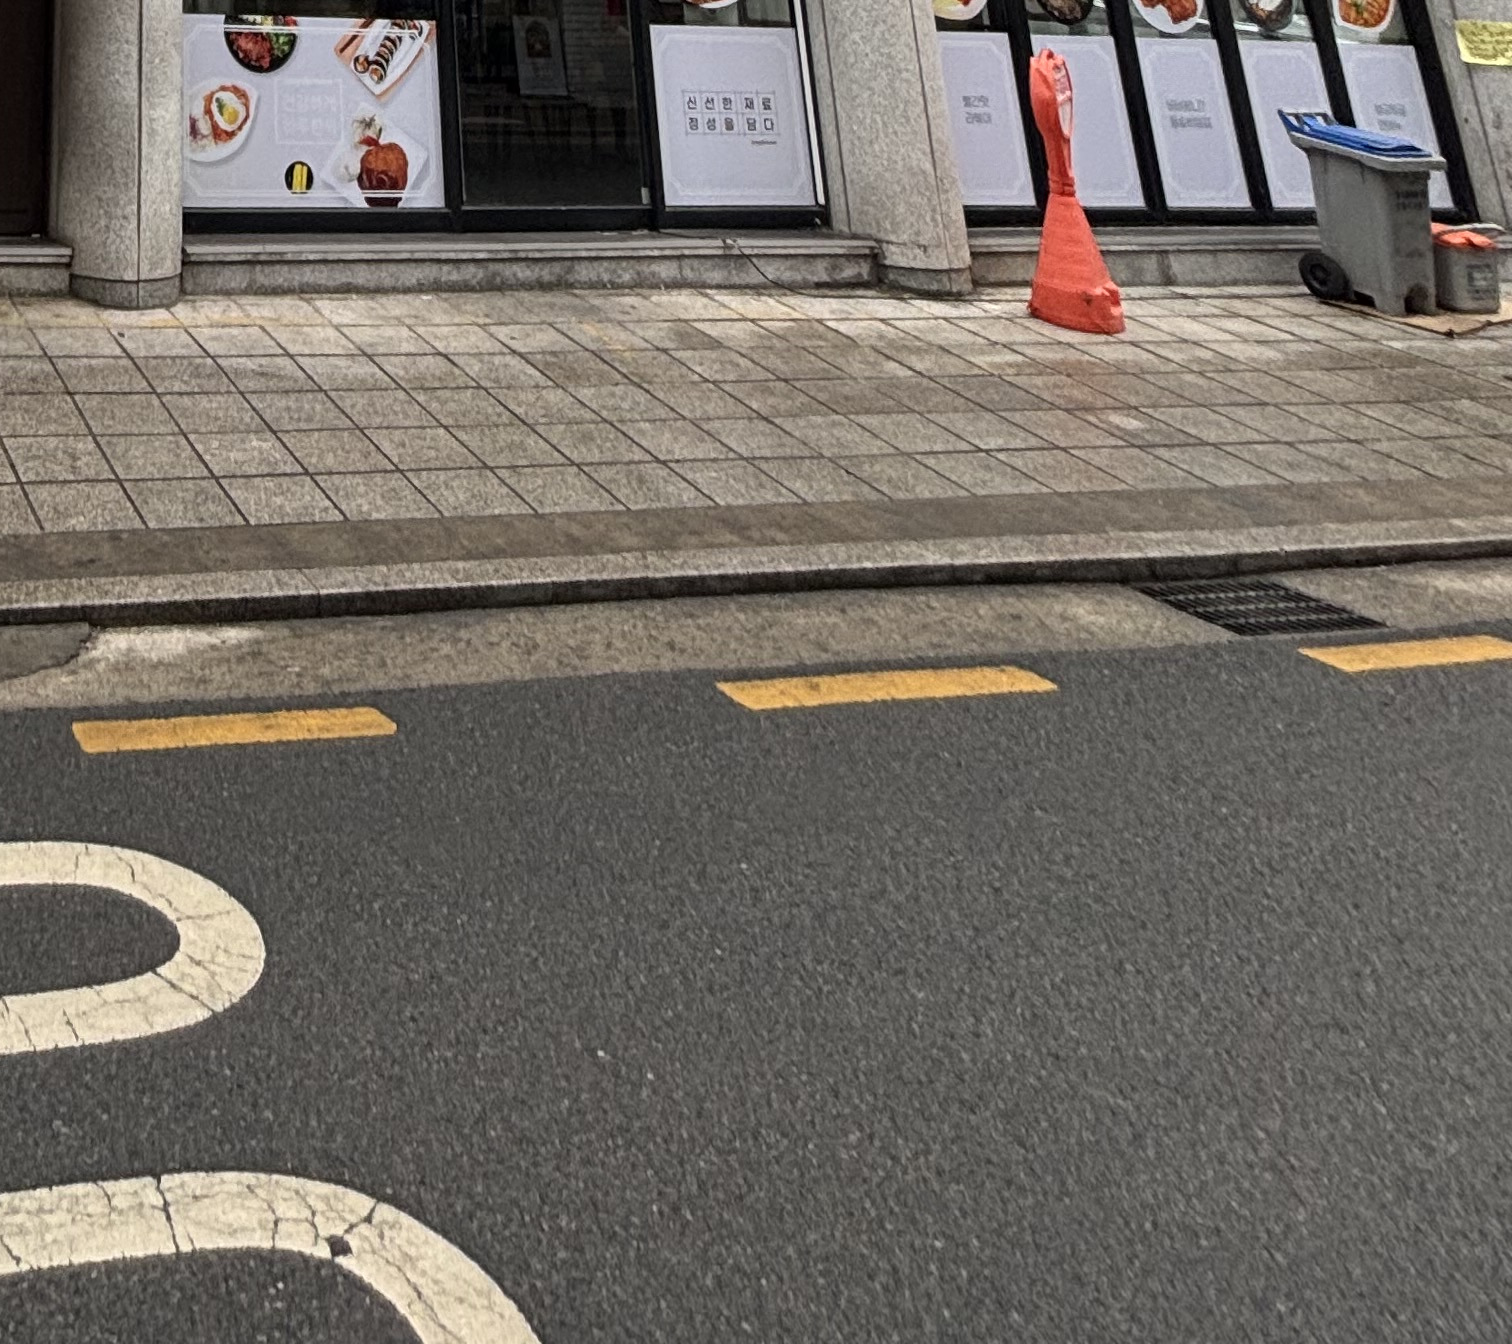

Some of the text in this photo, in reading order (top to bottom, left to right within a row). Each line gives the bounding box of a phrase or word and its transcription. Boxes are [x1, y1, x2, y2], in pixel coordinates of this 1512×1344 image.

[687, 96, 772, 111] 신선한 재료
[746, 117, 774, 131] 담다
